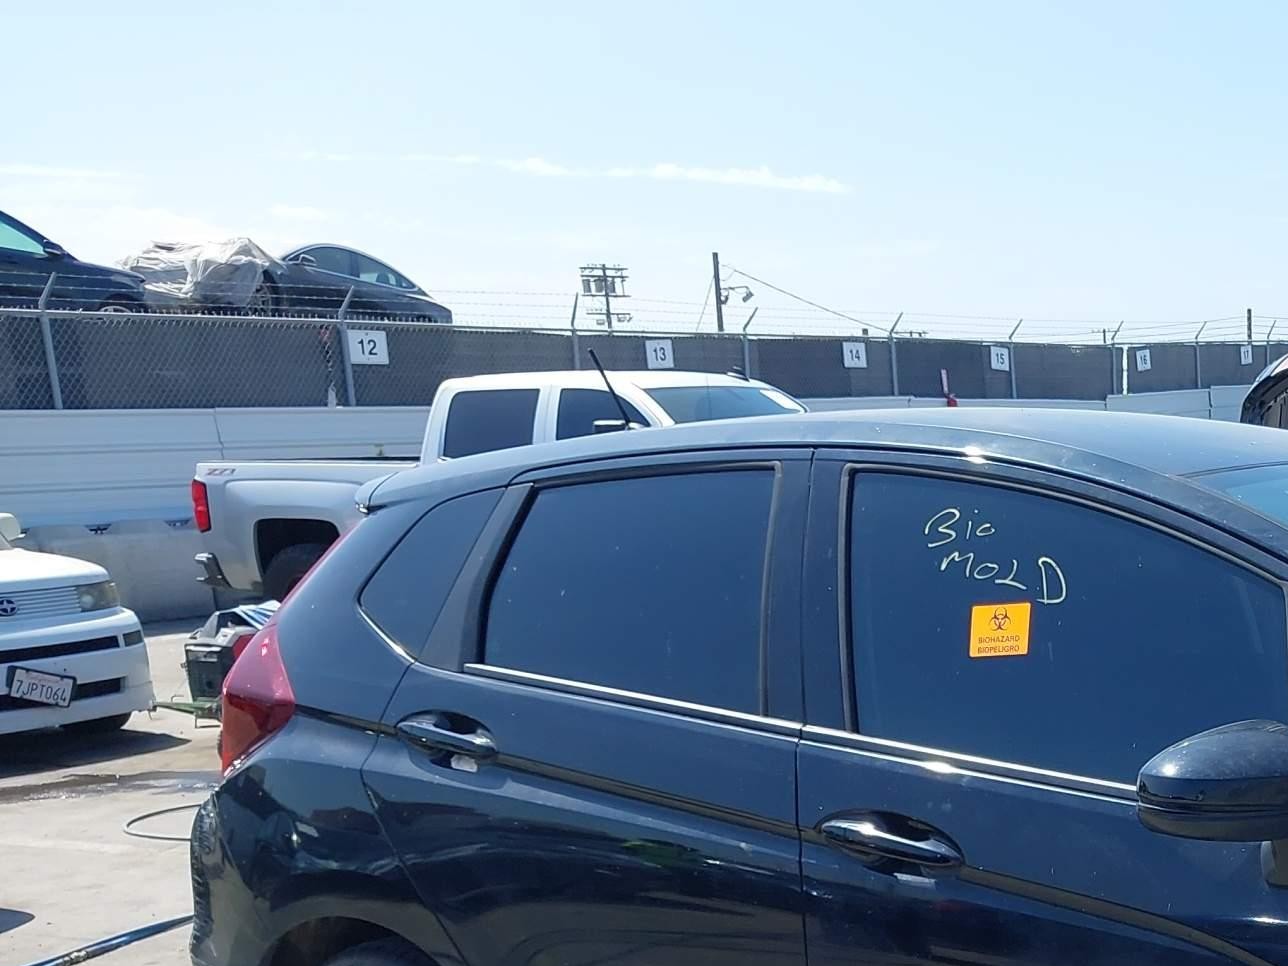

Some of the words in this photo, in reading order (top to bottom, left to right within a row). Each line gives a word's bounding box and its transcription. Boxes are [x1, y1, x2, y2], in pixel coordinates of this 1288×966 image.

[357, 338, 378, 356] 12
[653, 346, 667, 362] 13
[849, 349, 861, 361] 14
[996, 352, 1006, 365] 15
[978, 635, 1020, 644] BIOHAZARD
[977, 644, 1020, 655] BIOPELIGRO
[15, 680, 66, 703] 7JPT064
